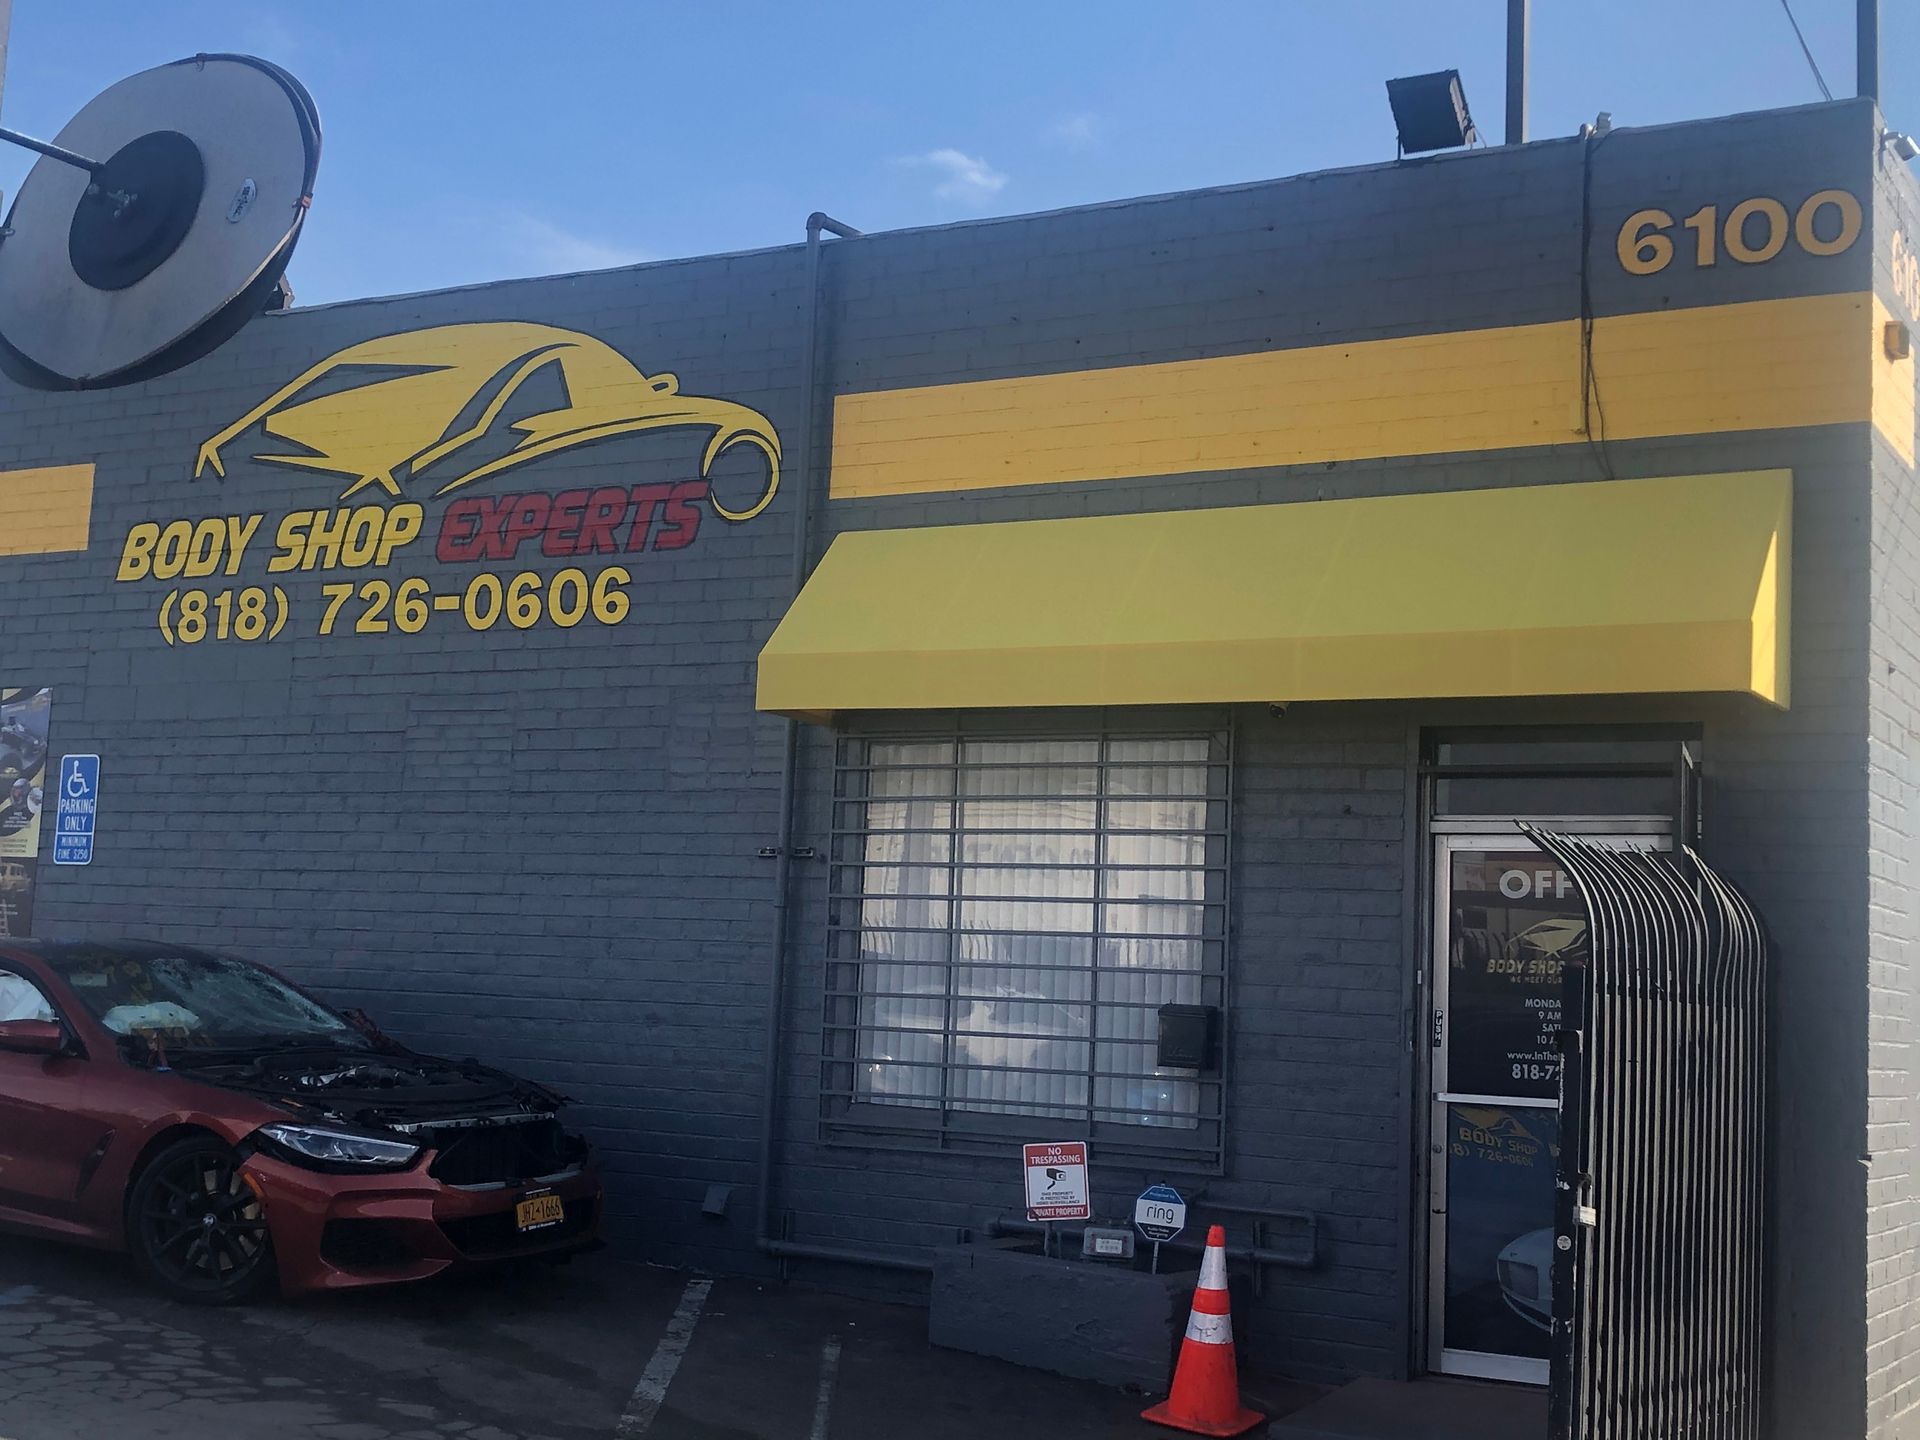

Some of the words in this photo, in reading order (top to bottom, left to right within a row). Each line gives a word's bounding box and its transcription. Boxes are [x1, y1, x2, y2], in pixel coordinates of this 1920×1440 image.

[1617, 189, 1863, 275] 6100
[116, 513, 264, 583] BODY
[269, 501, 424, 573] SHOP
[435, 479, 710, 565] EXPERTS
[158, 584, 289, 647] (818)
[319, 565, 632, 636] 726-0606
[60, 798, 95, 814] PARKING
[64, 815, 88, 831] ONLY
[61, 836, 87, 847] MINIMUM
[57, 848, 71, 859] FINE
[73, 848, 88, 860] $250
[1499, 869, 1577, 899] OFF
[1486, 958, 1525, 974] BODY
[1538, 1011, 1544, 1020] 9
[1434, 1010, 1443, 1040] PUSH
[1536, 1035, 1547, 1044] 10
[1047, 1147, 1062, 1155] NO
[1030, 1154, 1081, 1165] TRESPASSING
[1055, 1206, 1085, 1216] PROPERTY
[1146, 1204, 1174, 1224] ring
